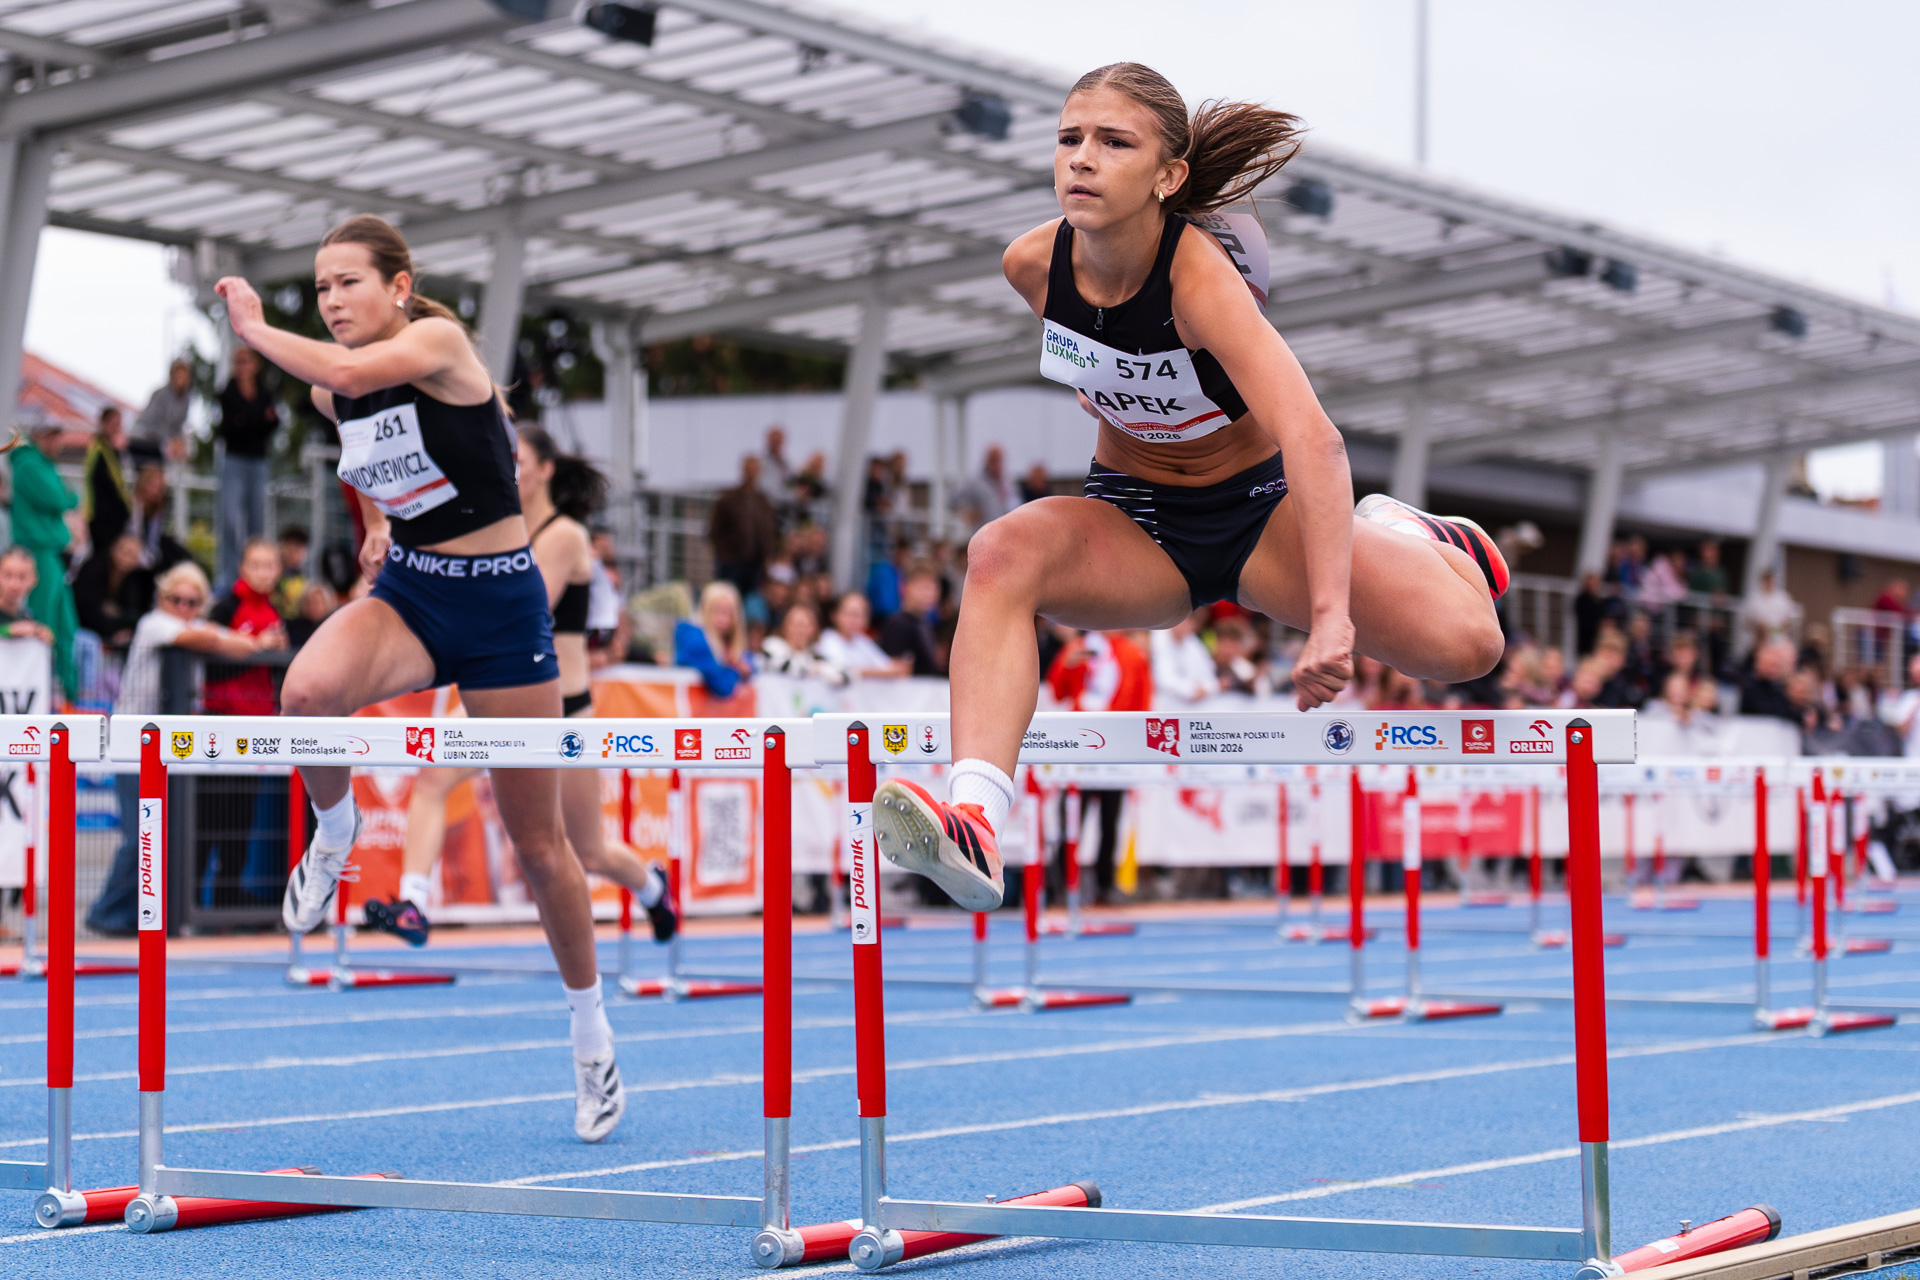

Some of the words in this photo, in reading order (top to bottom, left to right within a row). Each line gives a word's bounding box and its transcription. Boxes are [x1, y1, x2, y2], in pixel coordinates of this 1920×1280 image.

[1046, 329, 1079, 354] GRUPA
[1046, 341, 1086, 368] LUXMED
[1116, 357, 1178, 381] 574
[374, 414, 407, 442] 261
[1147, 432, 1182, 440] 2026
[406, 551, 468, 577] NIKE
[471, 552, 531, 577] PRO
[1190, 721, 1213, 731] PZLA
[444, 730, 463, 739] PZLA
[1023, 730, 1047, 741] oleje
[1190, 732, 1242, 740] MISTRZOSTWA
[1244, 731, 1269, 739] POLSKI
[1271, 731, 1285, 739] U16
[252, 737, 282, 746] DOLNY
[291, 737, 318, 747] Koleje
[444, 740, 488, 748] MISTRZOSTWA
[1020, 740, 1079, 751] olnośląskie
[1511, 741, 1552, 752] ORLEN
[10, 745, 40, 754] ORLEN
[252, 745, 280, 755] ŚLĄSK
[291, 746, 347, 756] Dolnośląskie
[1190, 743, 1218, 753] LUBIN
[1220, 743, 1244, 753] 2026
[444, 751, 467, 760] LUBIN
[469, 750, 489, 760] 2026
[716, 748, 749, 759] ORLEN
[140, 831, 156, 897] polanik
[850, 838, 869, 910] polanik
